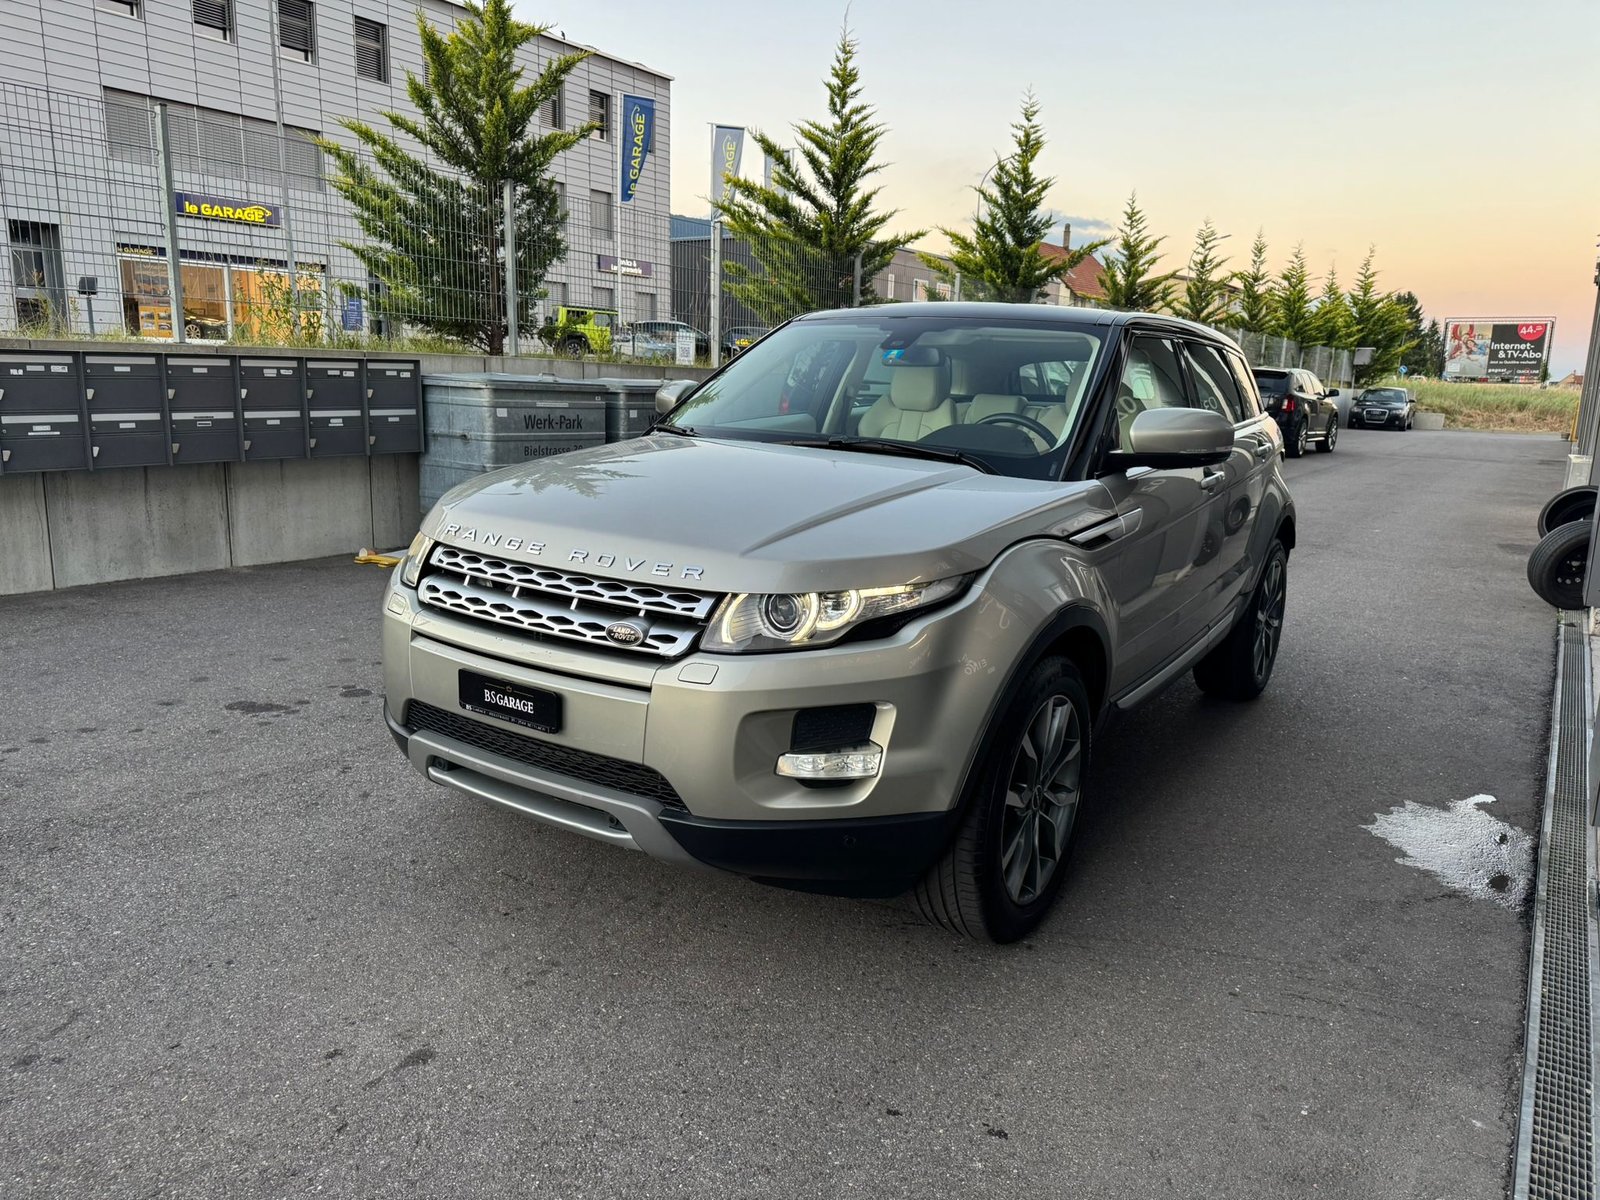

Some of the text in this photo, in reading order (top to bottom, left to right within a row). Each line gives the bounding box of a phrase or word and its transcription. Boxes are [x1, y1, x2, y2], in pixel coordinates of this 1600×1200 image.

[628, 113, 645, 195] le GARAGE
[185, 201, 265, 222] le GARAGE
[1491, 341, 1535, 350] Internet-
[1498, 350, 1542, 359] & TV-Abo
[524, 413, 583, 430] Werk-Park
[444, 524, 704, 580] RANGE ROVER
[613, 626, 631, 635] LAND
[614, 632, 635, 641] ROVER
